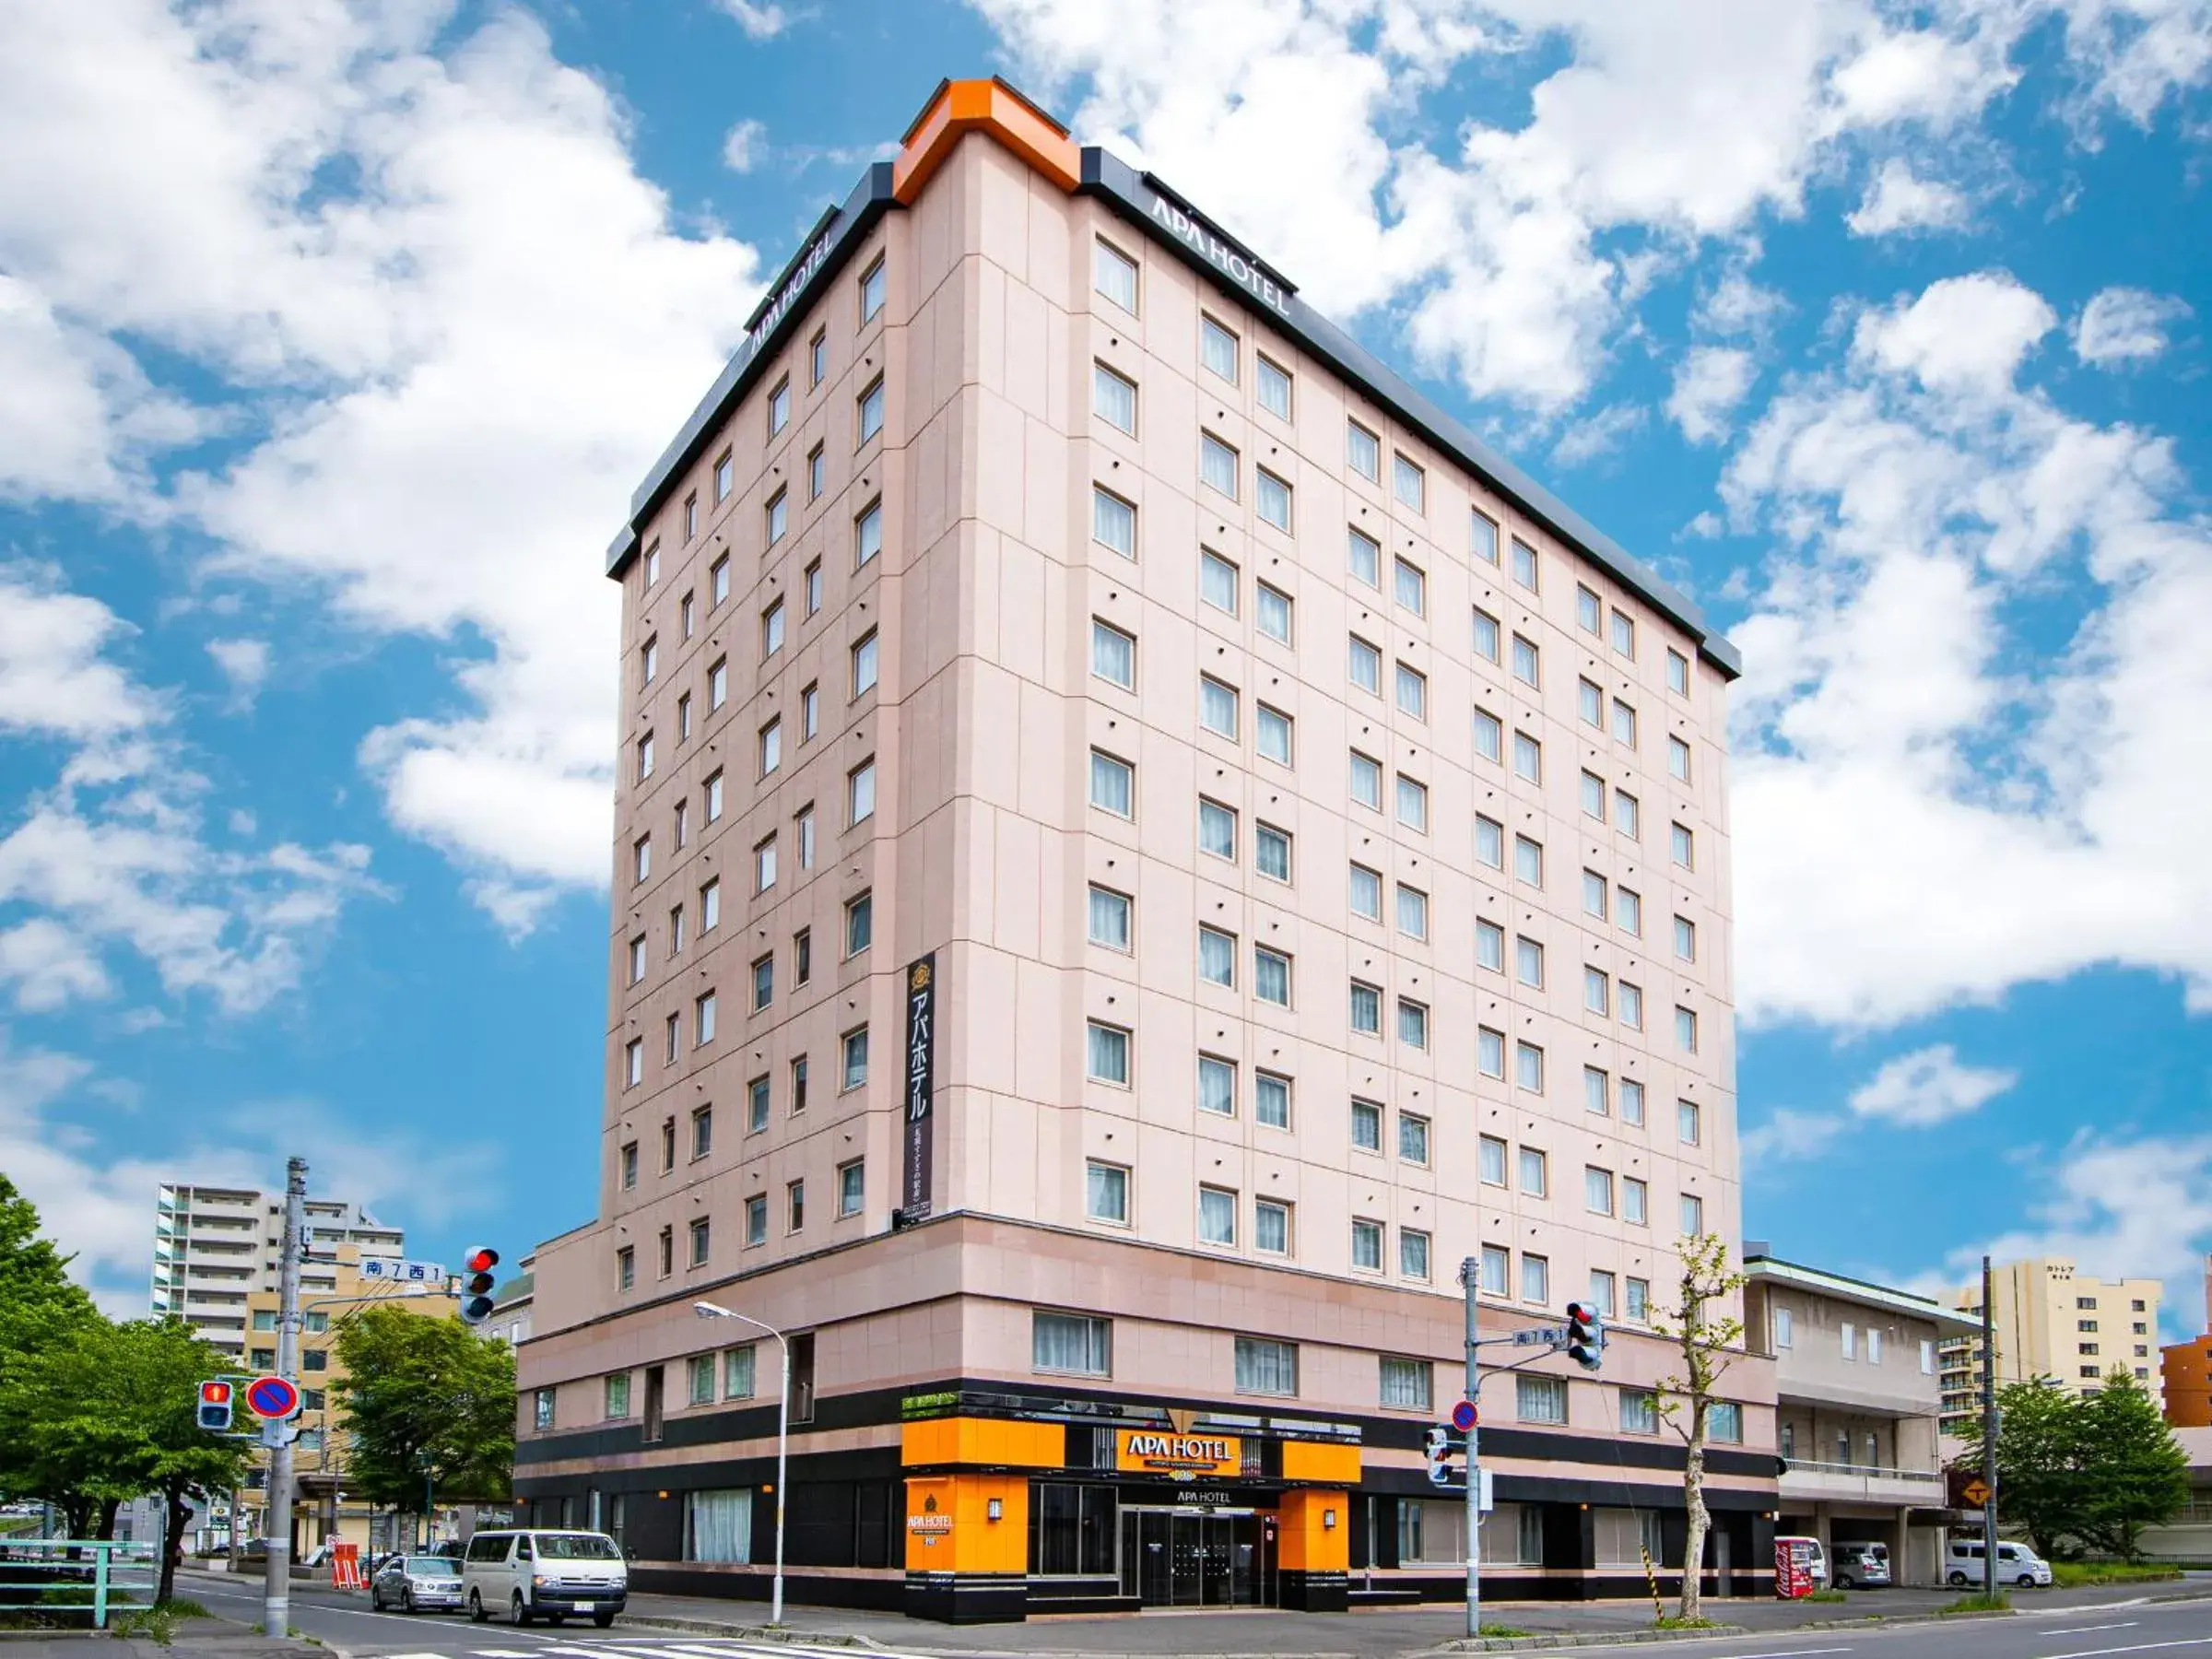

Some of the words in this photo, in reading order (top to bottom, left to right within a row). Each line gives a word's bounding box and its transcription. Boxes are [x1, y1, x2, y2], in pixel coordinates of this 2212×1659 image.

[1152, 195, 1206, 253] APA
[1209, 236, 1290, 317] HOTEL
[751, 303, 780, 356] APA
[782, 230, 833, 312] HOTEL
[910, 991, 929, 1121] アパホテル
[1129, 1436, 1171, 1456] APA
[1172, 1438, 1232, 1460] HOTEL
[925, 1515, 954, 1529] HOTEL
[1177, 1491, 1198, 1502] APA
[1199, 1491, 1231, 1504] HOTEL
